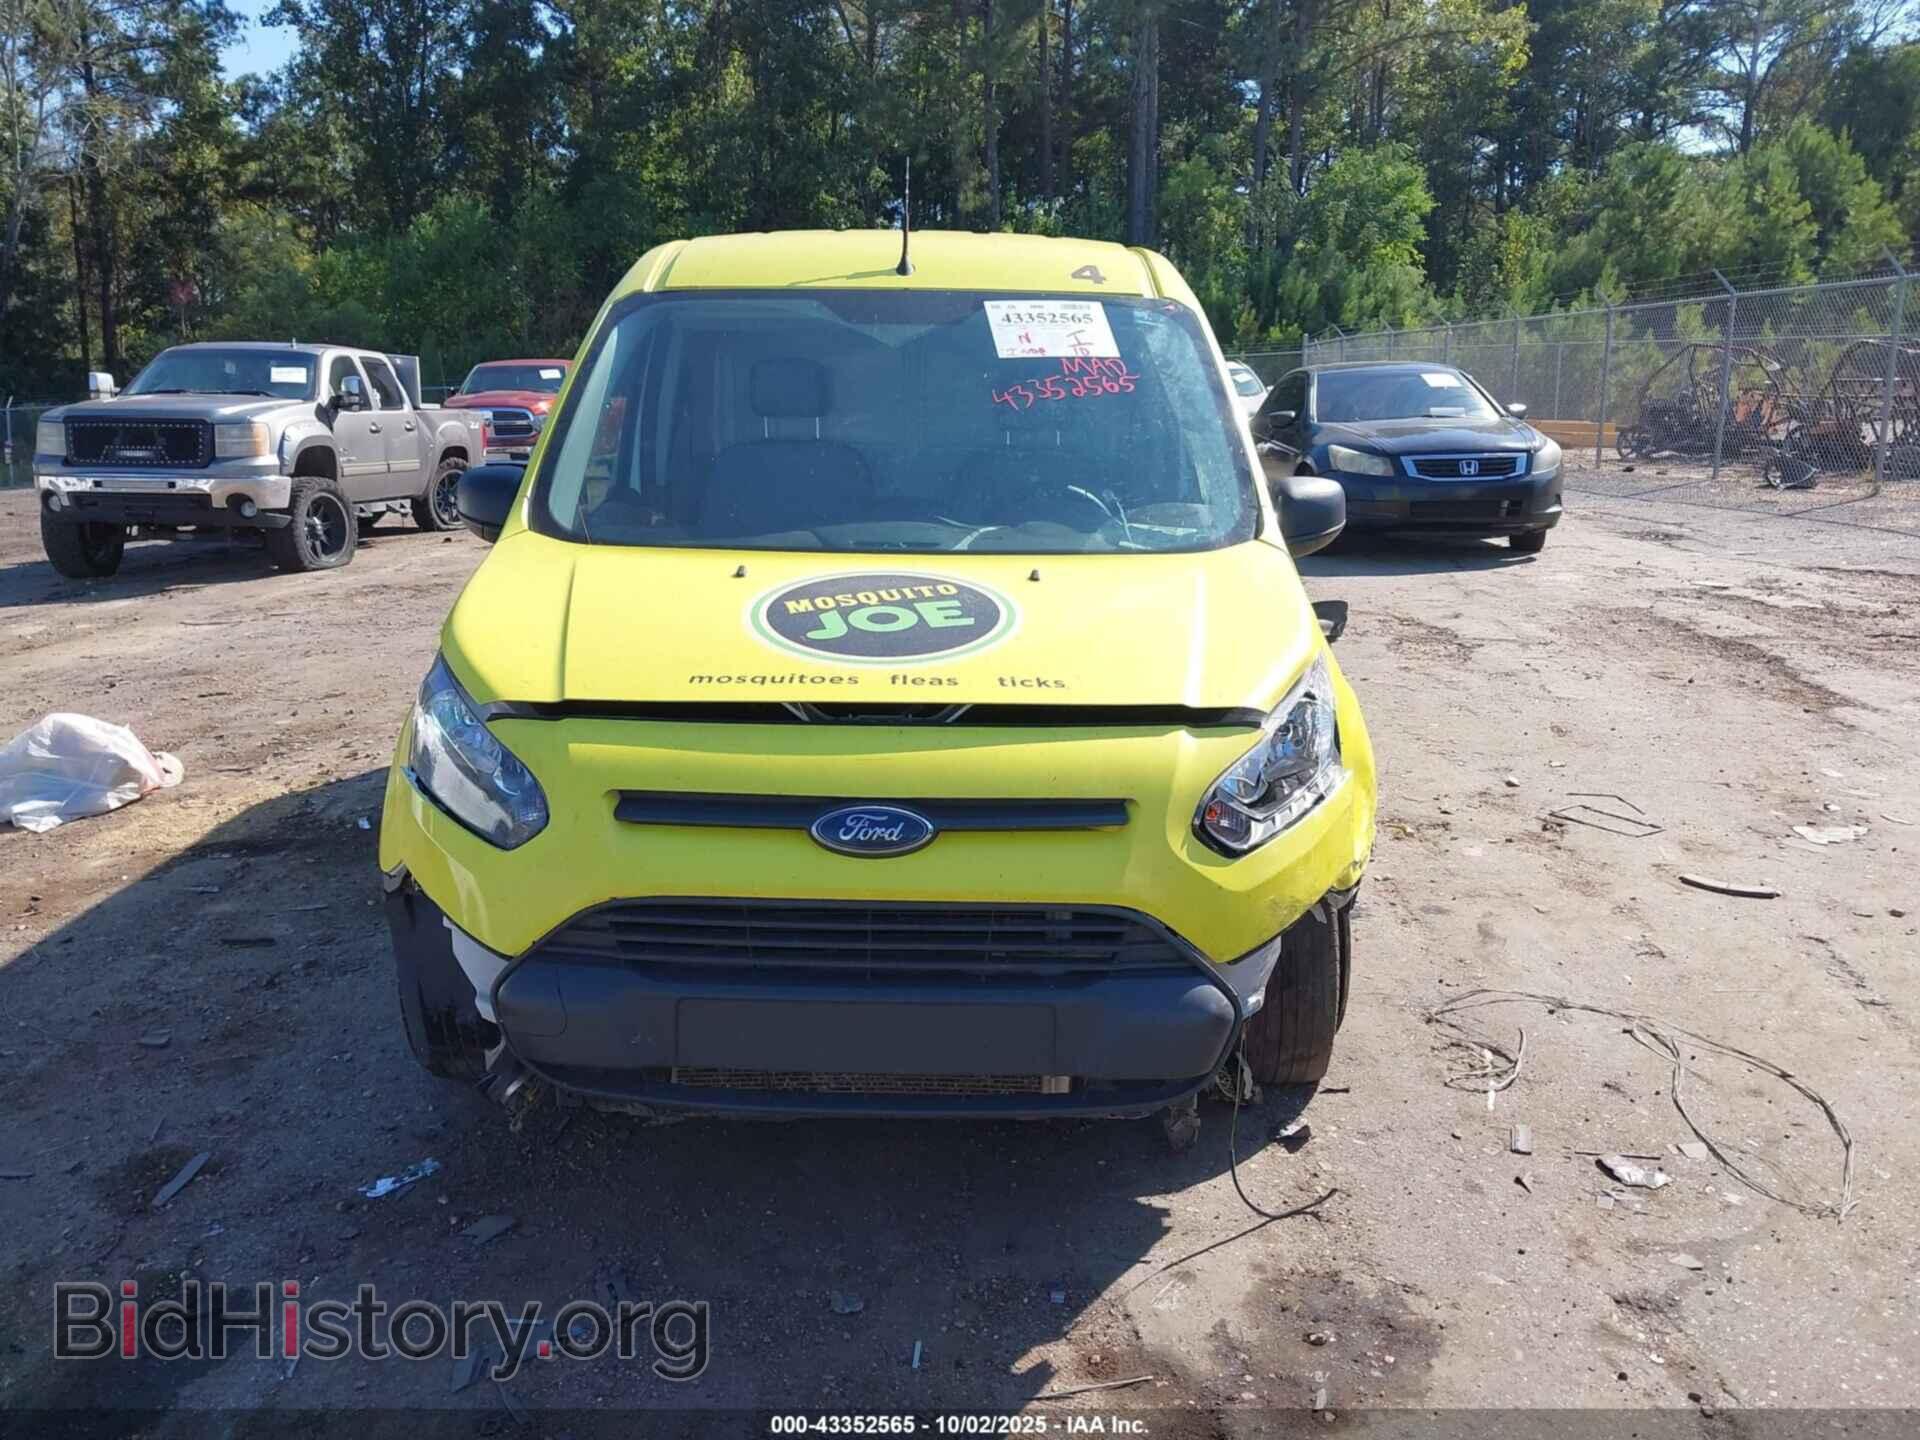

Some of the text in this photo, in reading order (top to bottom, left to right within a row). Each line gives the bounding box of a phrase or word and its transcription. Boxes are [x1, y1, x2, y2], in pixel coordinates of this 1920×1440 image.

[1071, 265, 1106, 284] 4
[1002, 312, 1093, 324] 43352565
[992, 374, 1140, 411] 43352565
[784, 584, 959, 615] MOSQUITO
[806, 600, 975, 640] JOE
[689, 672, 1066, 689] mosquitoes fleas ticks
[839, 814, 905, 841] Ford
